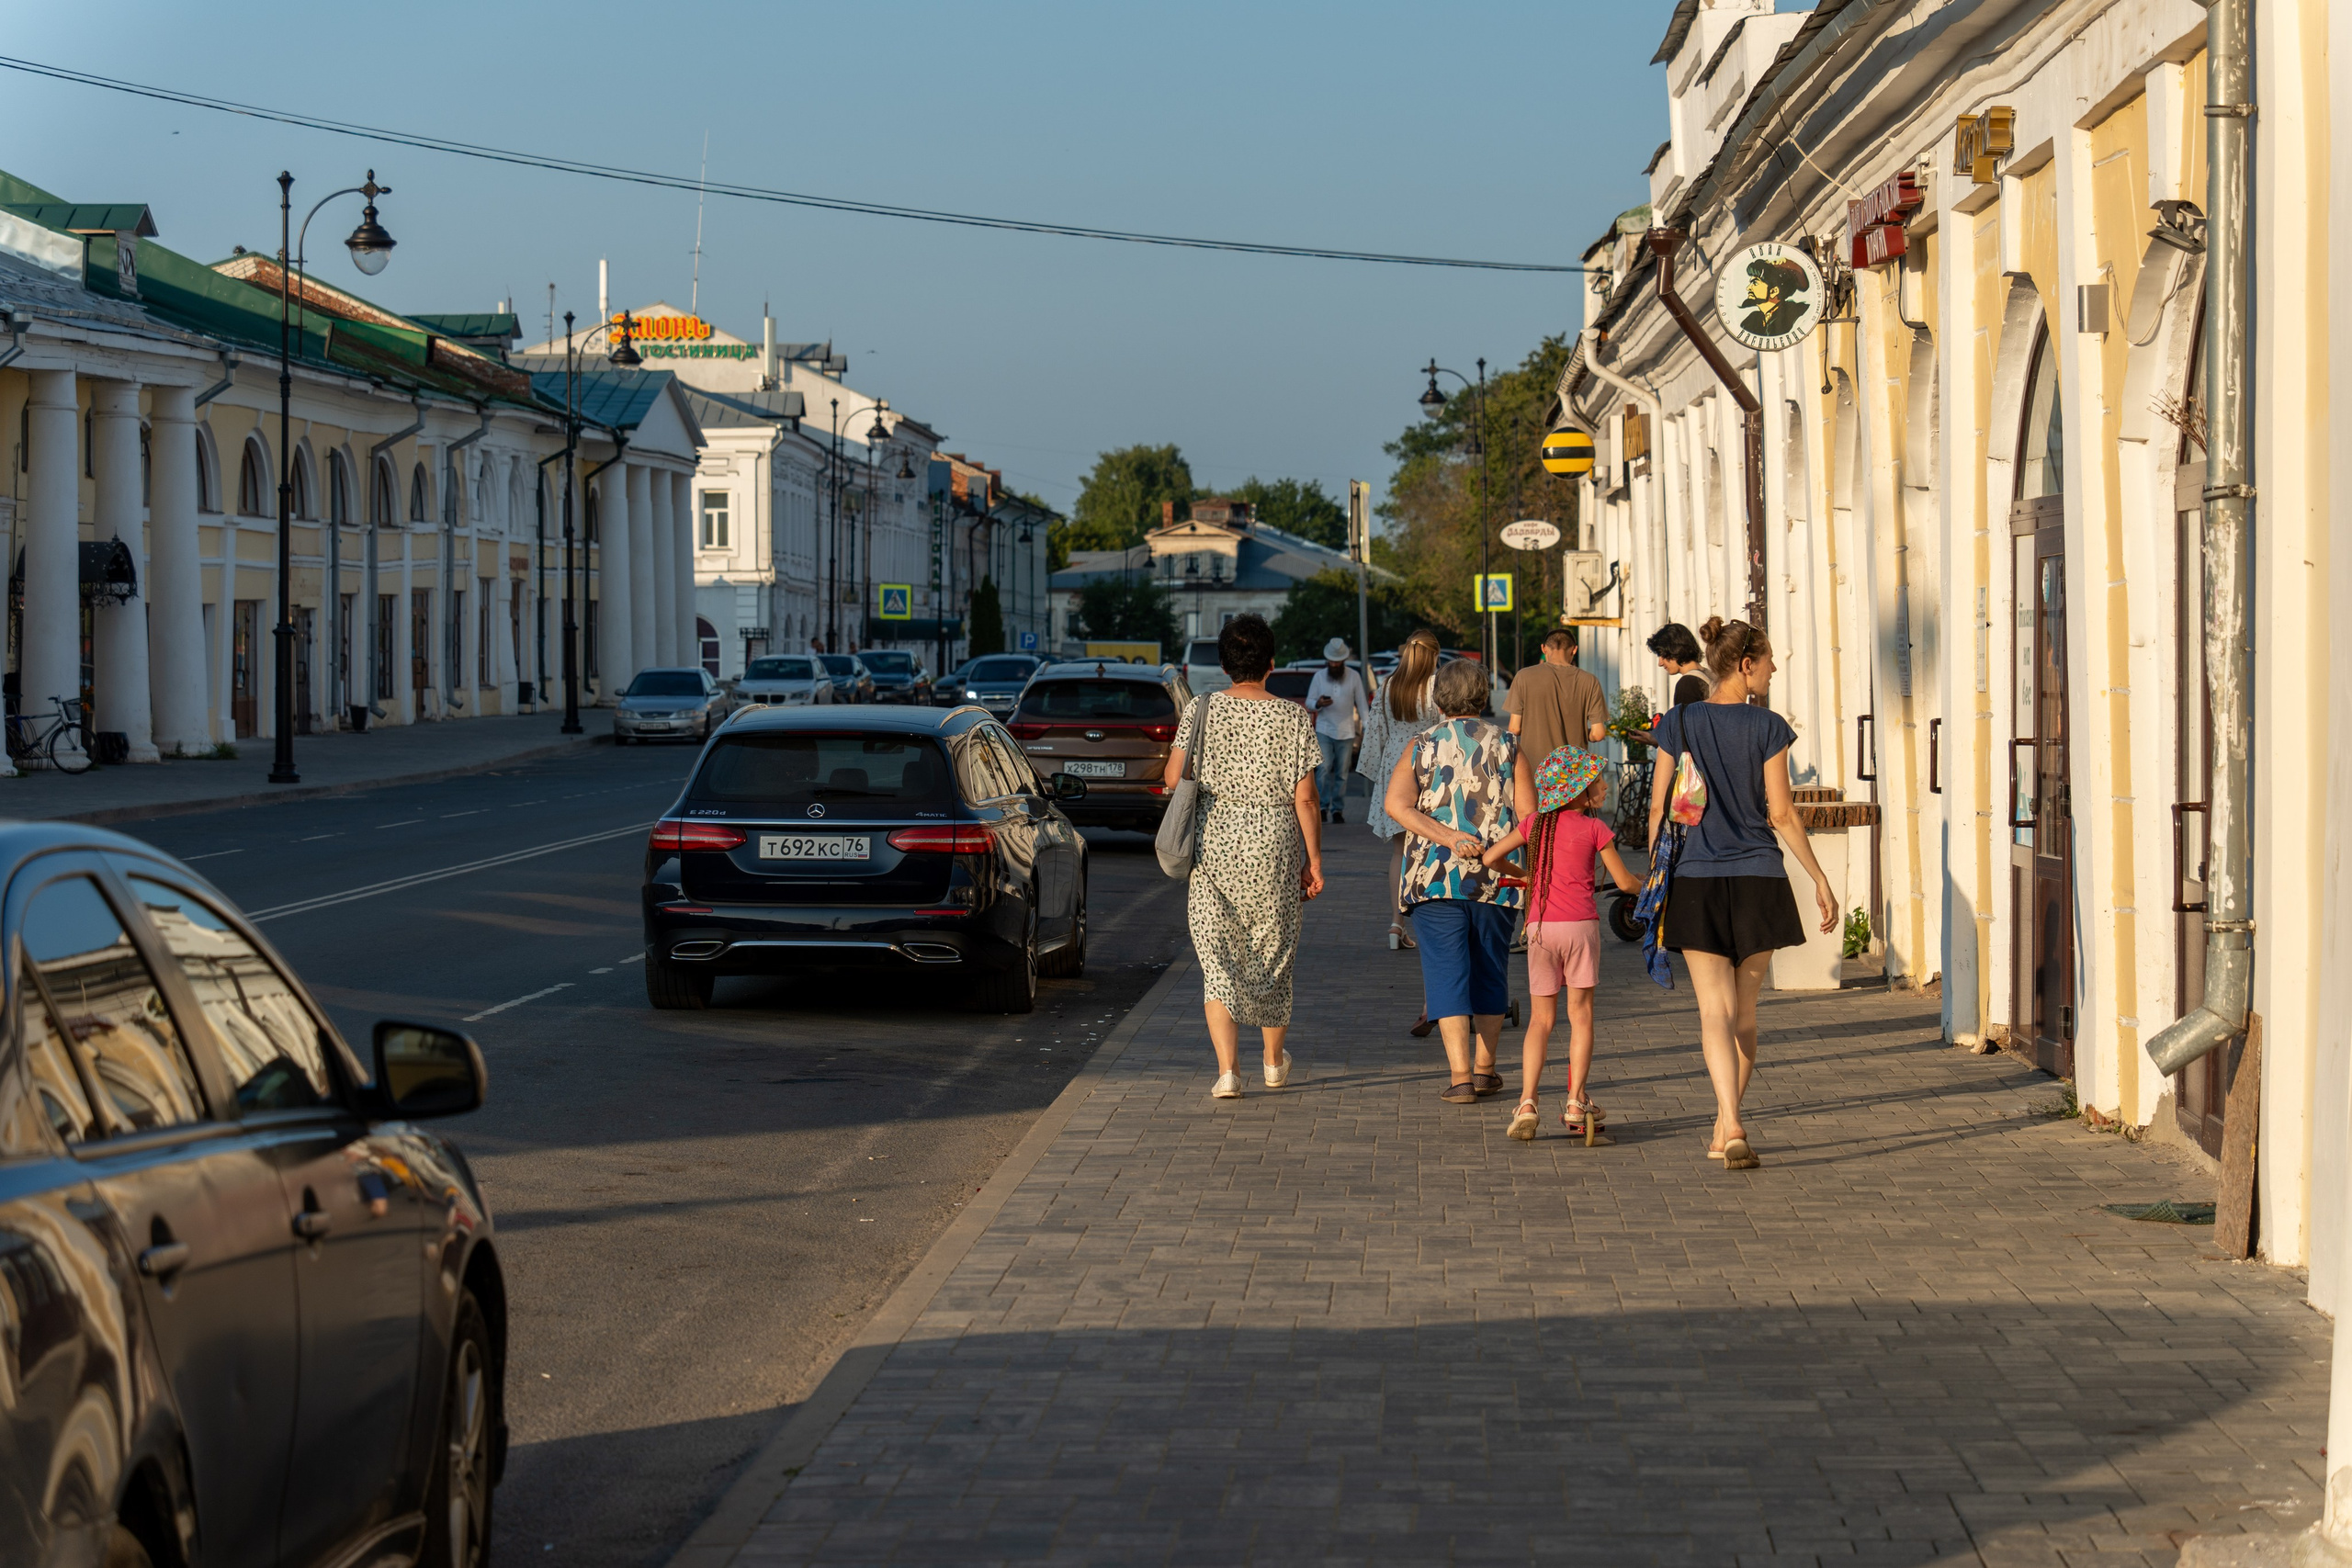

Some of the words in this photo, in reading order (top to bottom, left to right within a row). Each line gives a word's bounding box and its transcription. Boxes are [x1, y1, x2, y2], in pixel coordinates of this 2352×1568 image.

[1748, 243, 1782, 259] ИВАН
[1811, 271, 1821, 290] October
[1718, 276, 1731, 325] COFFEE
[1736, 326, 1806, 349] ВАСИЛЬЕВИЧ
[639, 344, 756, 362] ГОСТИНИЦА
[1024, 634, 1035, 648] P
[2022, 646, 2030, 665] на
[1107, 763, 1123, 772] 178
[842, 838, 860, 851] 76
